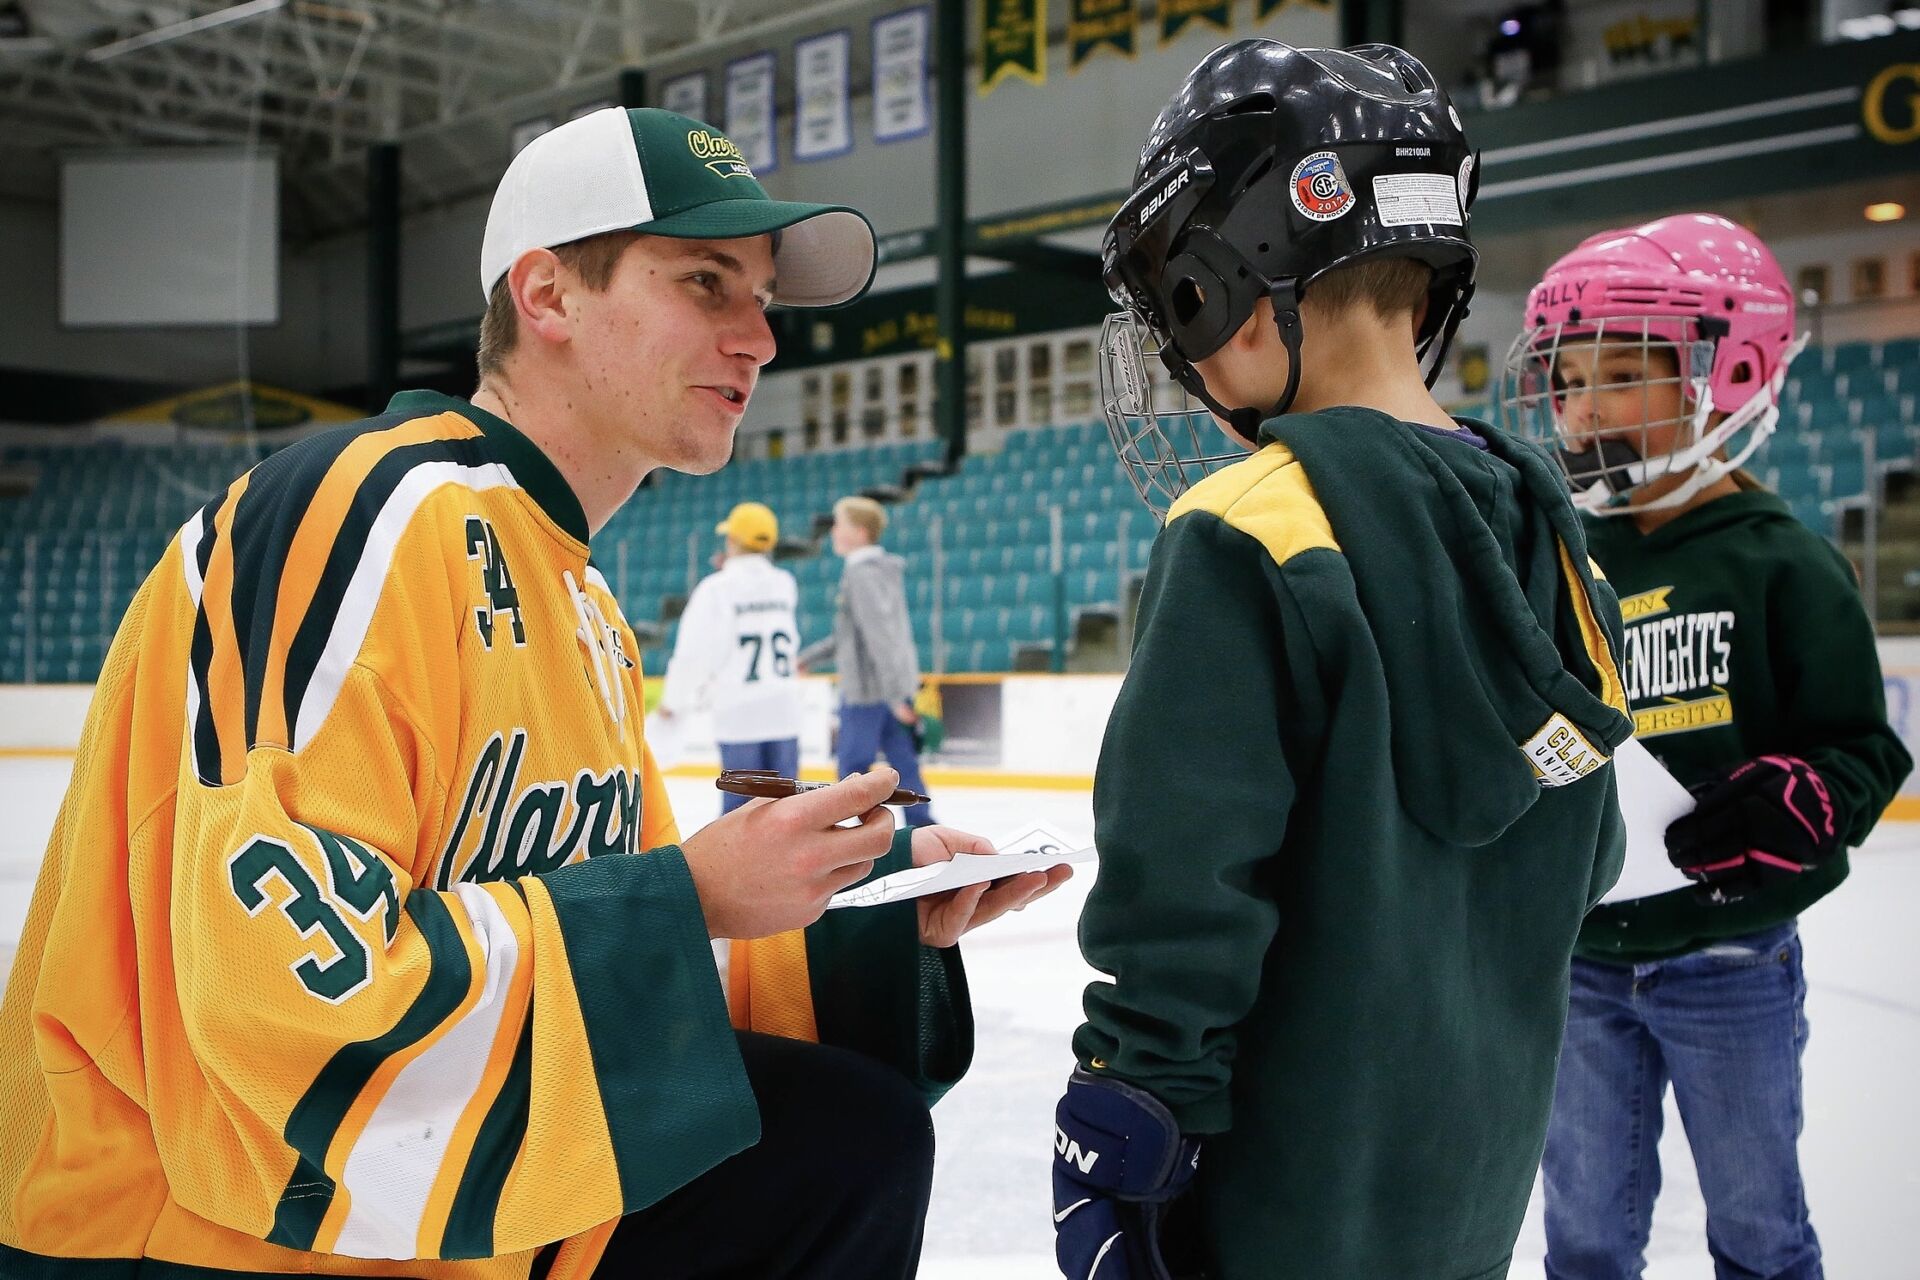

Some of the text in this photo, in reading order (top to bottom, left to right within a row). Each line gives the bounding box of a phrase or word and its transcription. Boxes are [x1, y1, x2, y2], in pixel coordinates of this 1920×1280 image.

[1291, 162, 1305, 189] CERTIFIED
[1305, 152, 1329, 163] HOCKEY
[1295, 198, 1315, 217] CASQUE
[1326, 203, 1350, 219] HOCKEY
[1318, 196, 1345, 211] 2012
[1536, 279, 1590, 309] ALLY
[464, 514, 527, 652] 34
[739, 630, 792, 683] 76
[226, 819, 402, 1007] 34
